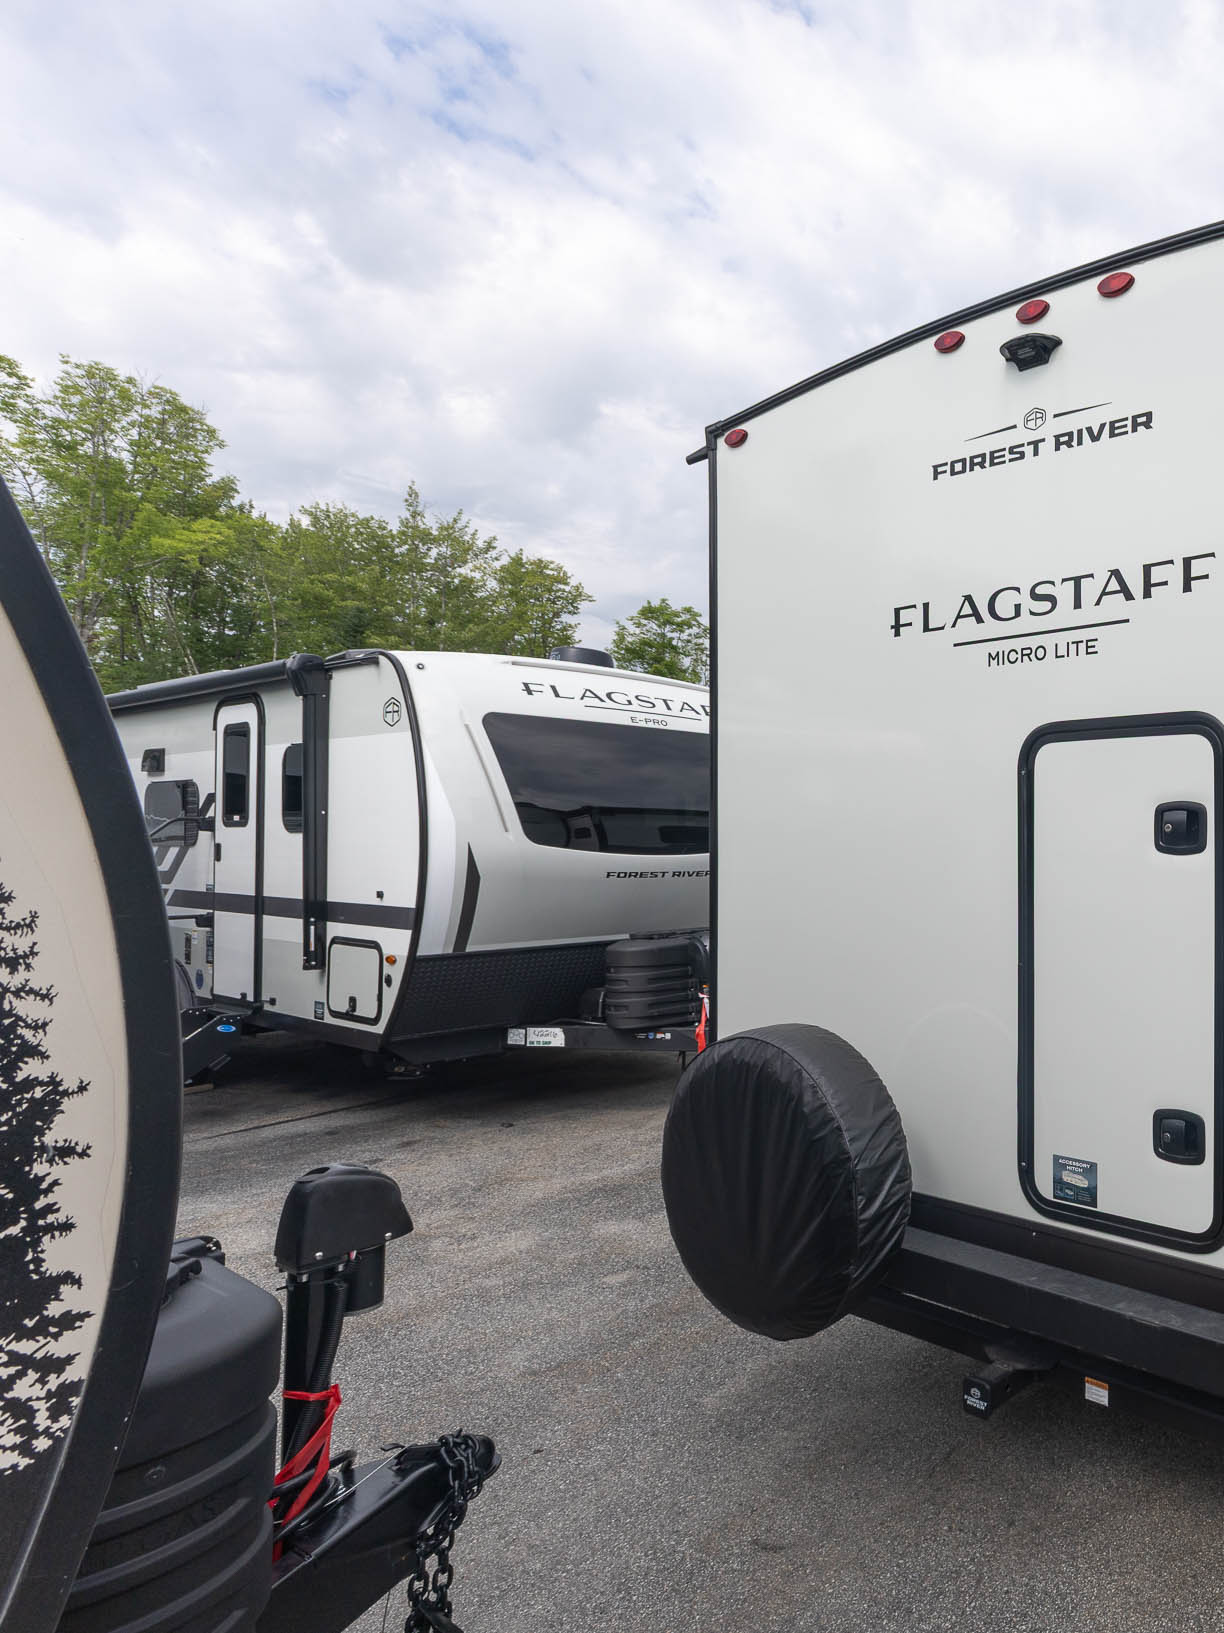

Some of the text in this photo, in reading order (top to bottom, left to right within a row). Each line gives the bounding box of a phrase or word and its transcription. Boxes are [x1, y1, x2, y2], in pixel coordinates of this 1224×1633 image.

[932, 410, 1154, 481] FOREST RIVER
[890, 551, 1216, 638] FLAGSTAFF
[987, 637, 1099, 667] MICRO LITE
[630, 716, 668, 727] E-PRO
[605, 871, 669, 879] FOREST
[1058, 1158, 1091, 1169] ACCESSORY
[1066, 1165, 1083, 1173] HITCH
